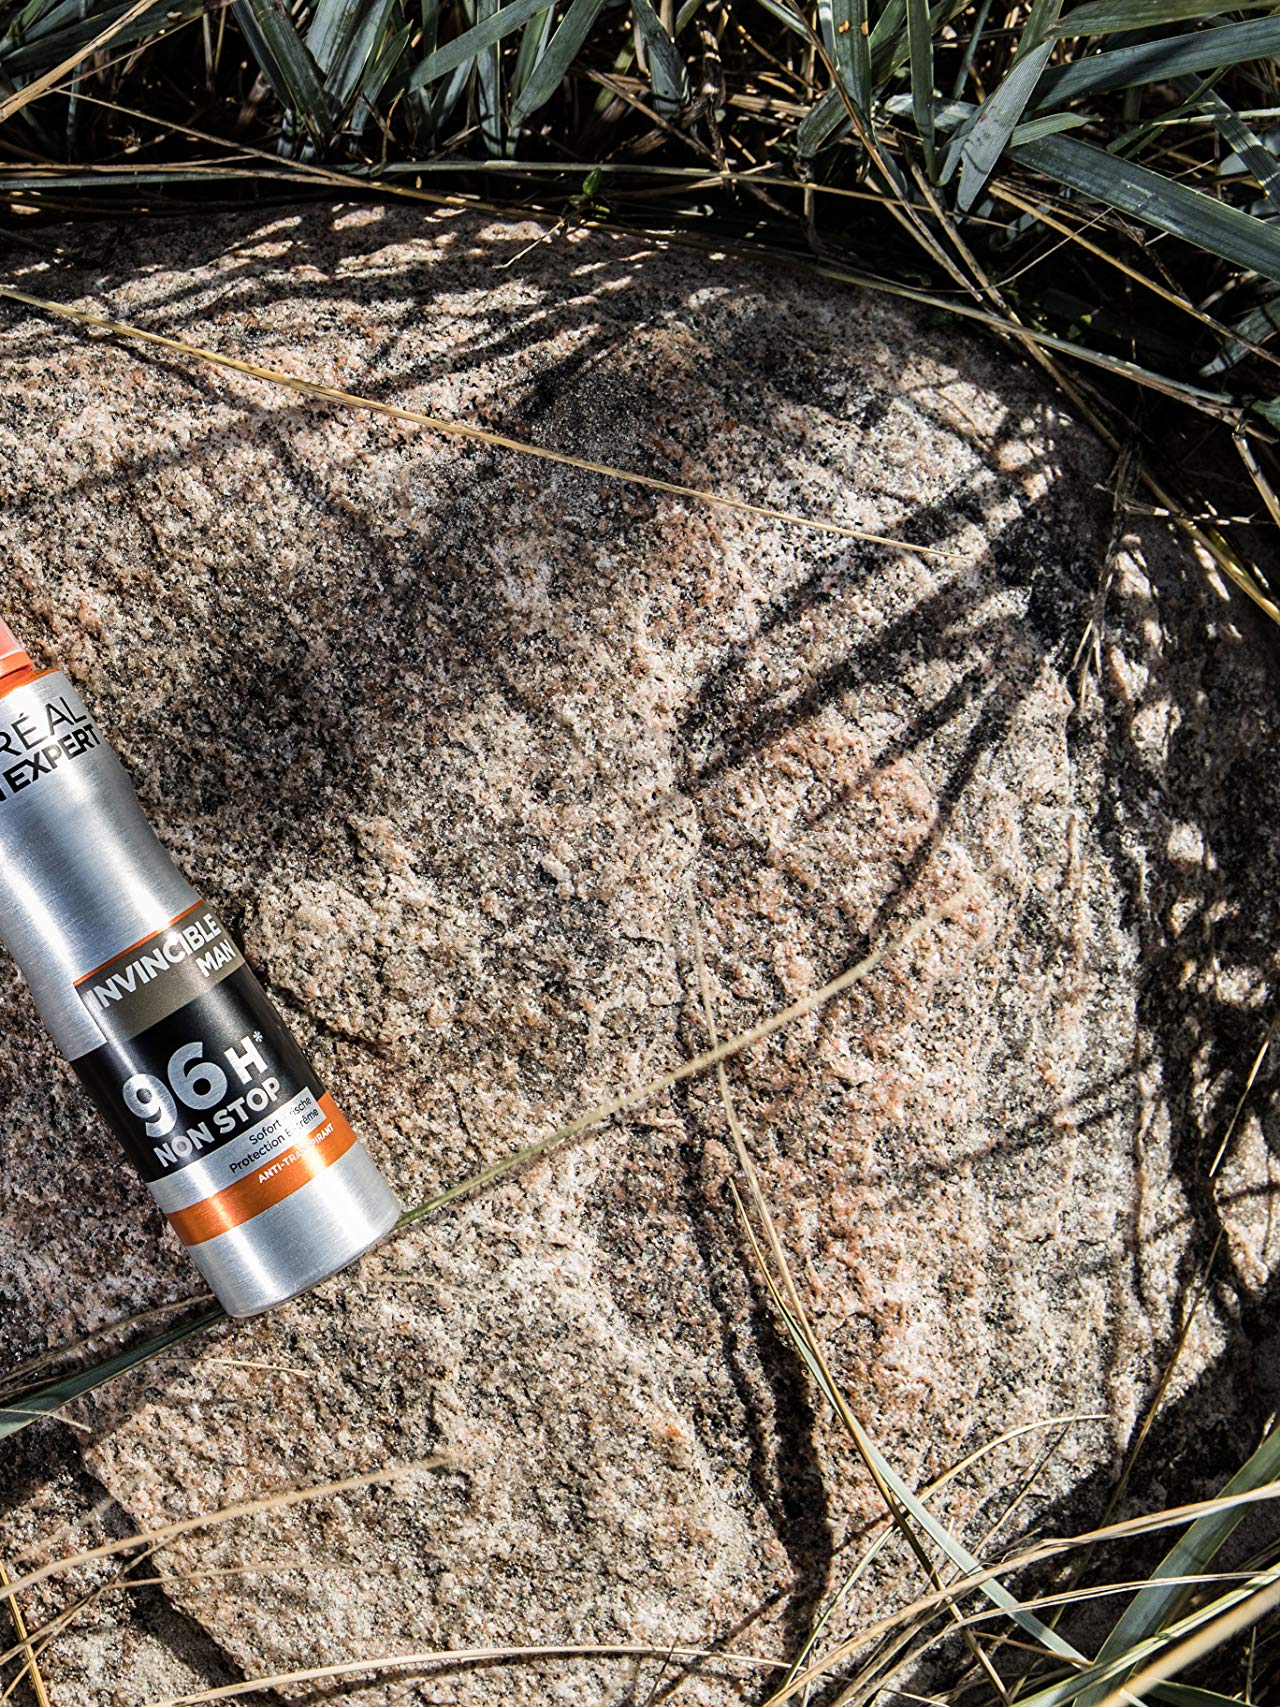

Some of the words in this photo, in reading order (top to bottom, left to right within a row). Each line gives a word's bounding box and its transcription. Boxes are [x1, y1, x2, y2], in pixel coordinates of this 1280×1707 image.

[2, 724, 101, 793] EXPERT
[81, 913, 221, 1012] INVINCIBLE
[195, 939, 236, 977] MAN
[153, 1121, 215, 1168] NON
[213, 1076, 280, 1134] STOP
[248, 1119, 282, 1145] Sofort
[229, 1134, 286, 1173] Protection
